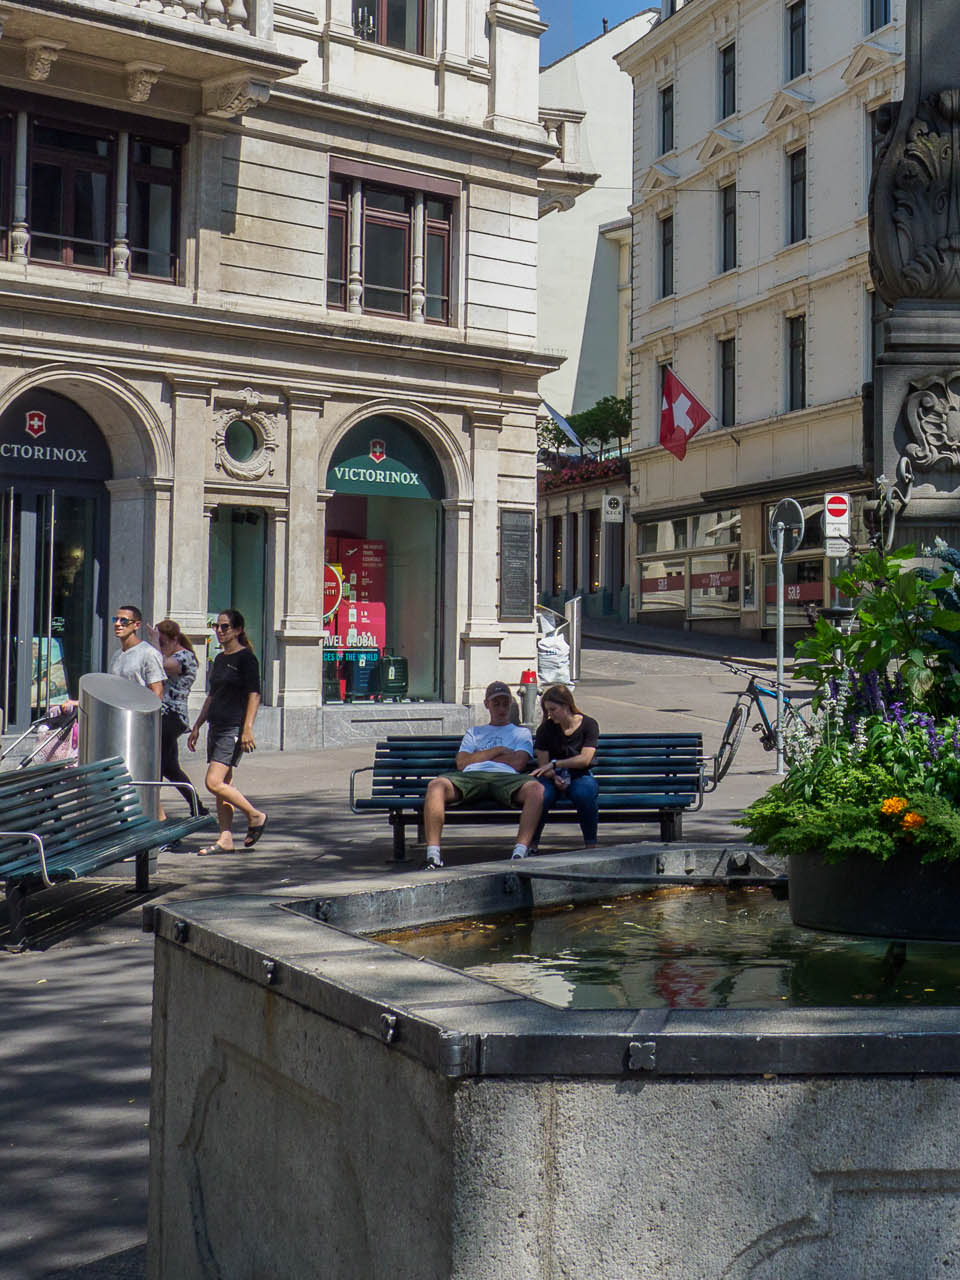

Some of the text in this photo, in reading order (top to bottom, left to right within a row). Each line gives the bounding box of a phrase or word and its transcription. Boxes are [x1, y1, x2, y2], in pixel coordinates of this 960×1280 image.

[0, 444, 88, 462] CTORINOX
[335, 467, 419, 485] VICTORINOX
[787, 584, 800, 600] sale
[346, 635, 378, 647] GLOBAL
[337, 652, 344, 661] OF
[345, 652, 358, 661] THE
